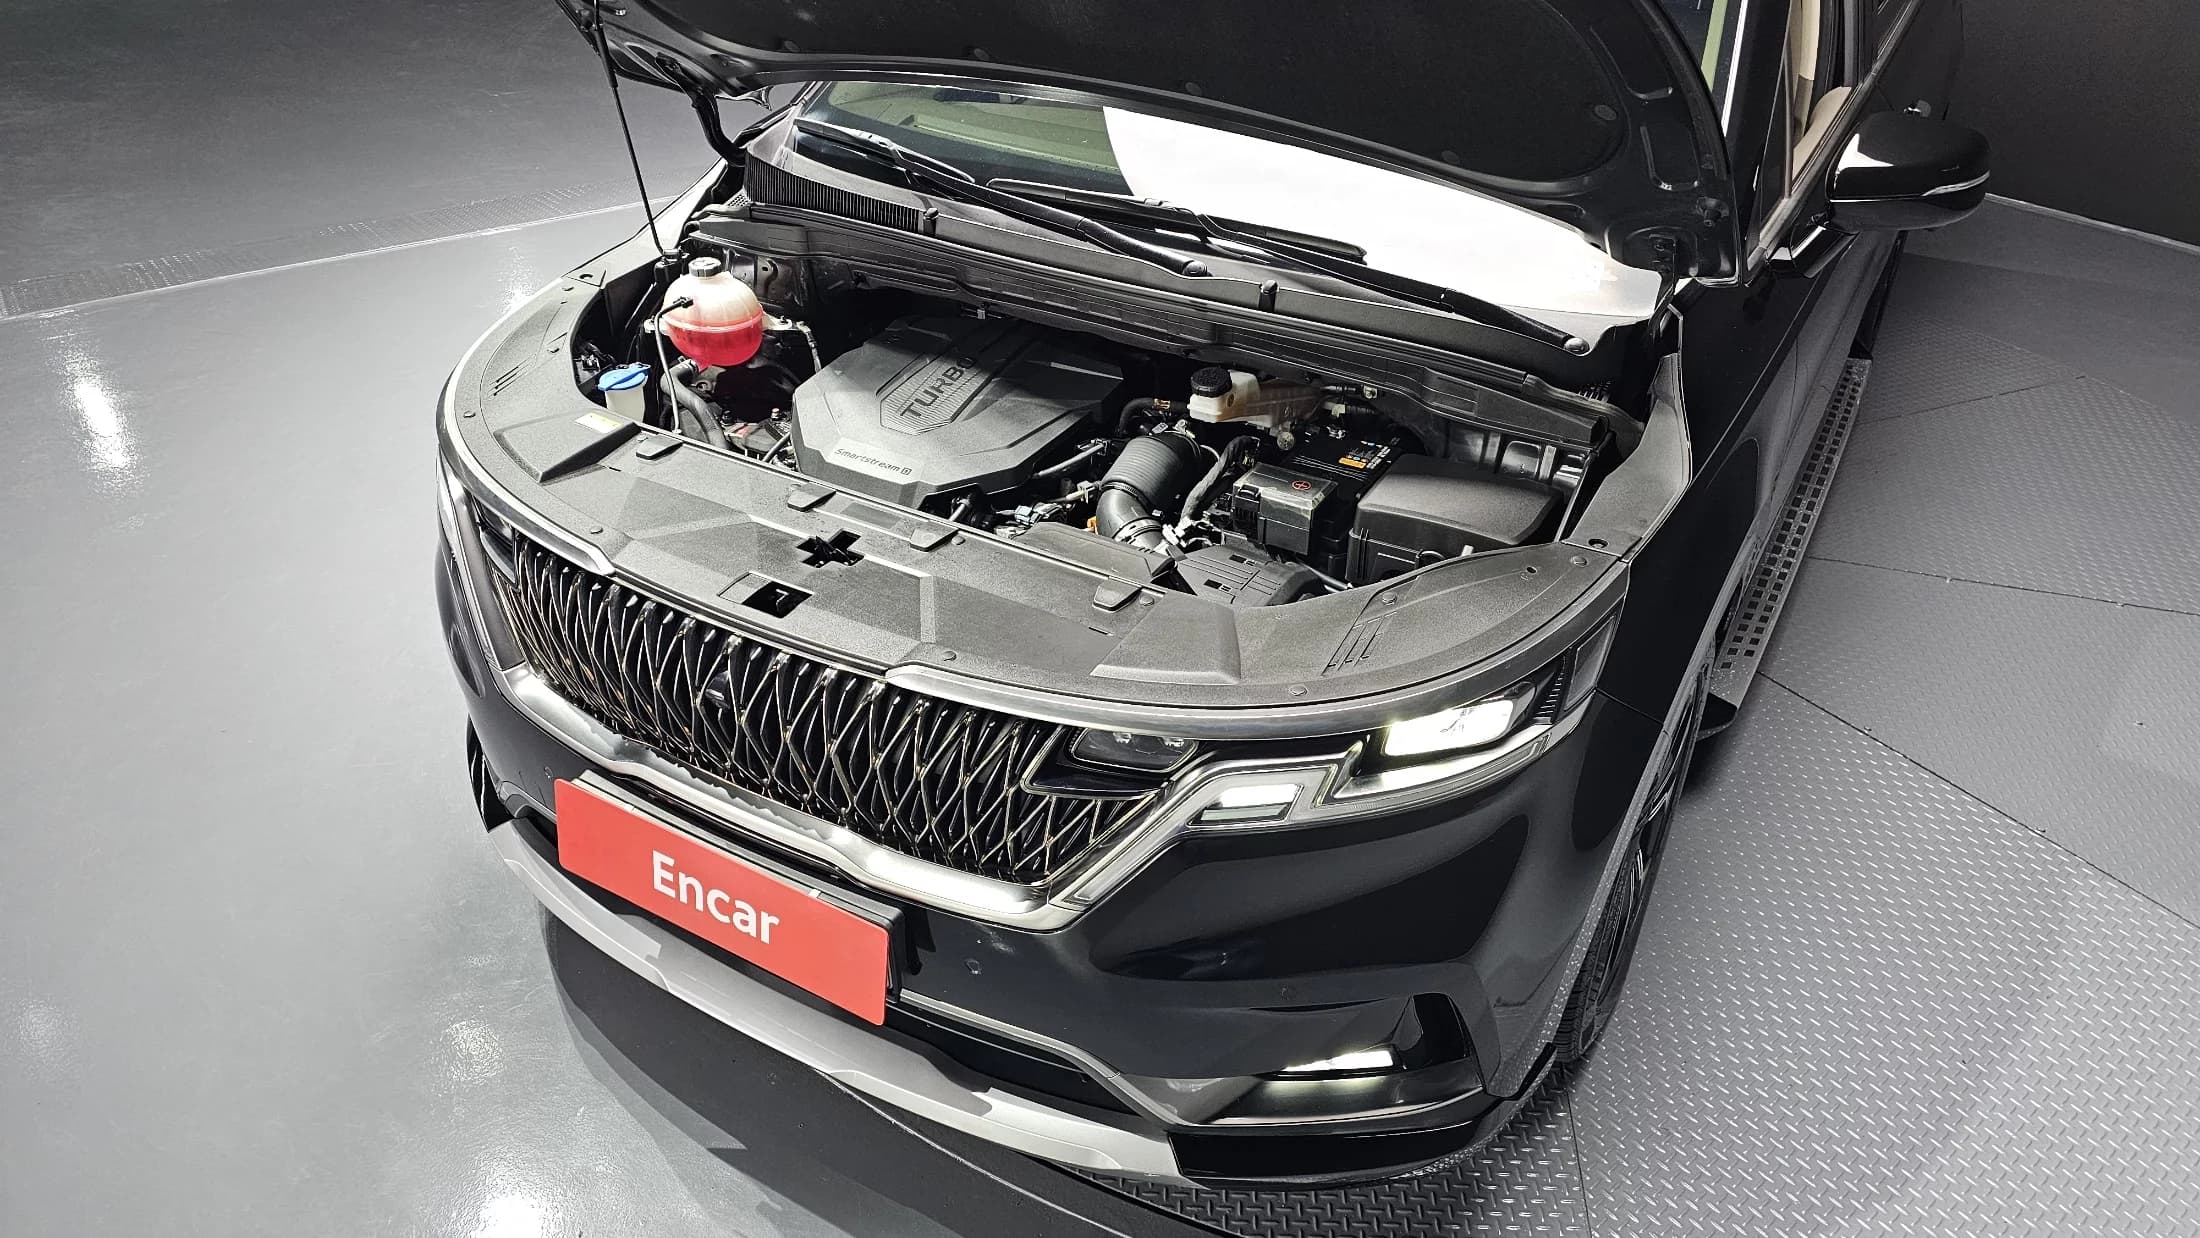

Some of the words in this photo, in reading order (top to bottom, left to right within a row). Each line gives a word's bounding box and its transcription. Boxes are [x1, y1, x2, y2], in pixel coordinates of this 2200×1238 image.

[900, 357, 976, 417] TURBO
[834, 448, 901, 472] Smartstream
[652, 849, 780, 944] Encar
